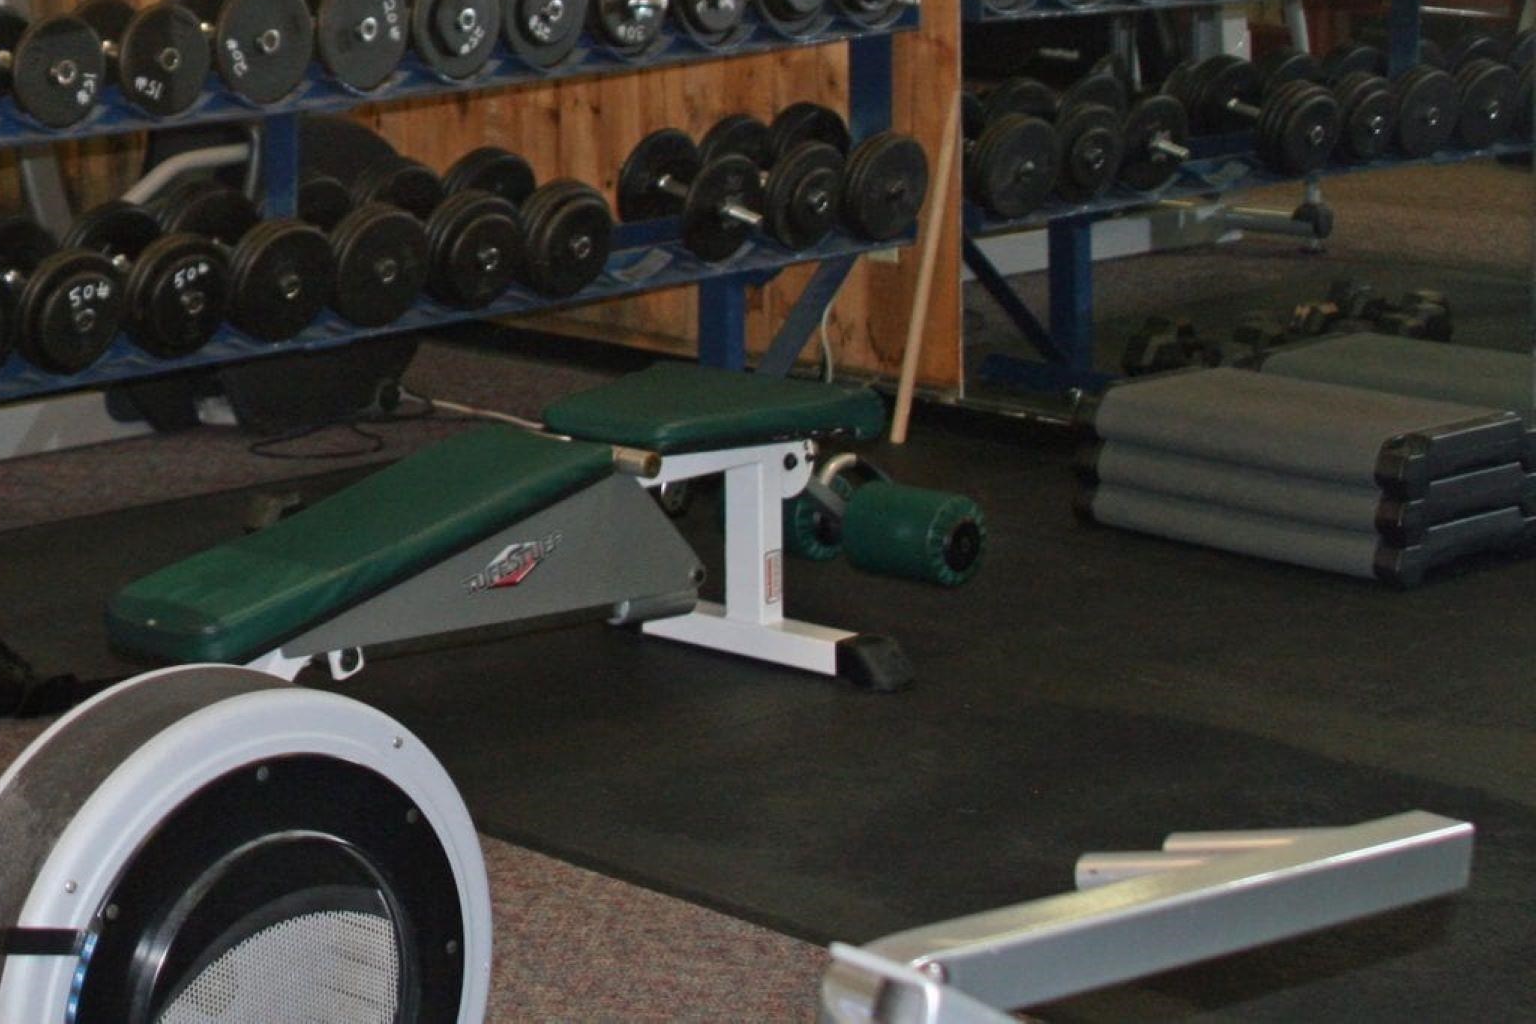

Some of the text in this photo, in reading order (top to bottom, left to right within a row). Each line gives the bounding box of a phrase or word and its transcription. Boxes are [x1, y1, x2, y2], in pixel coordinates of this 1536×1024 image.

[135, 76, 163, 101] 15#
[175, 261, 210, 289] 50#
[69, 280, 110, 308] 50#
